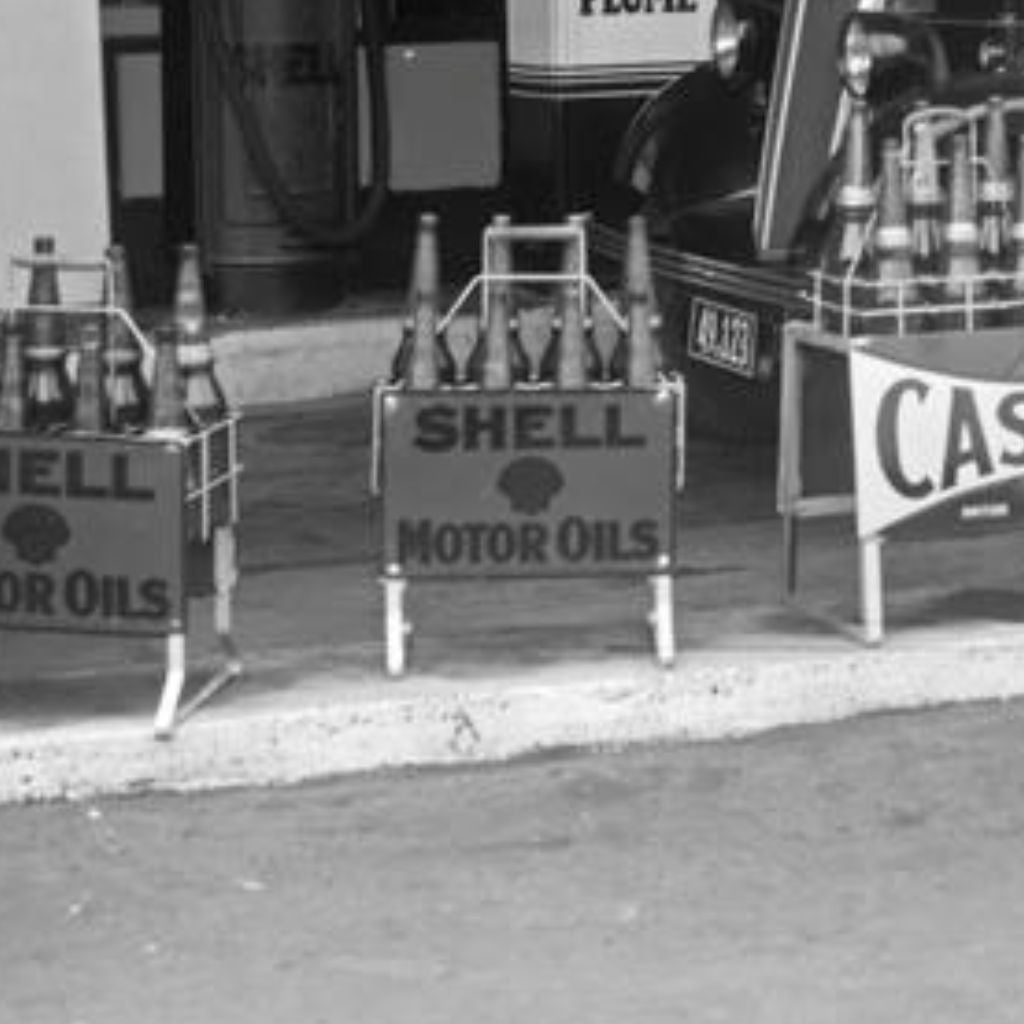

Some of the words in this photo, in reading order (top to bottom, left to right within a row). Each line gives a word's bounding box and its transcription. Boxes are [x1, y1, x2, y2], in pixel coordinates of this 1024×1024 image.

[414, 404, 646, 453] SHELL
[0, 447, 155, 501] ELL
[399, 517, 549, 565] MOTOR
[556, 515, 660, 562] OILS
[64, 569, 169, 619] OILS
